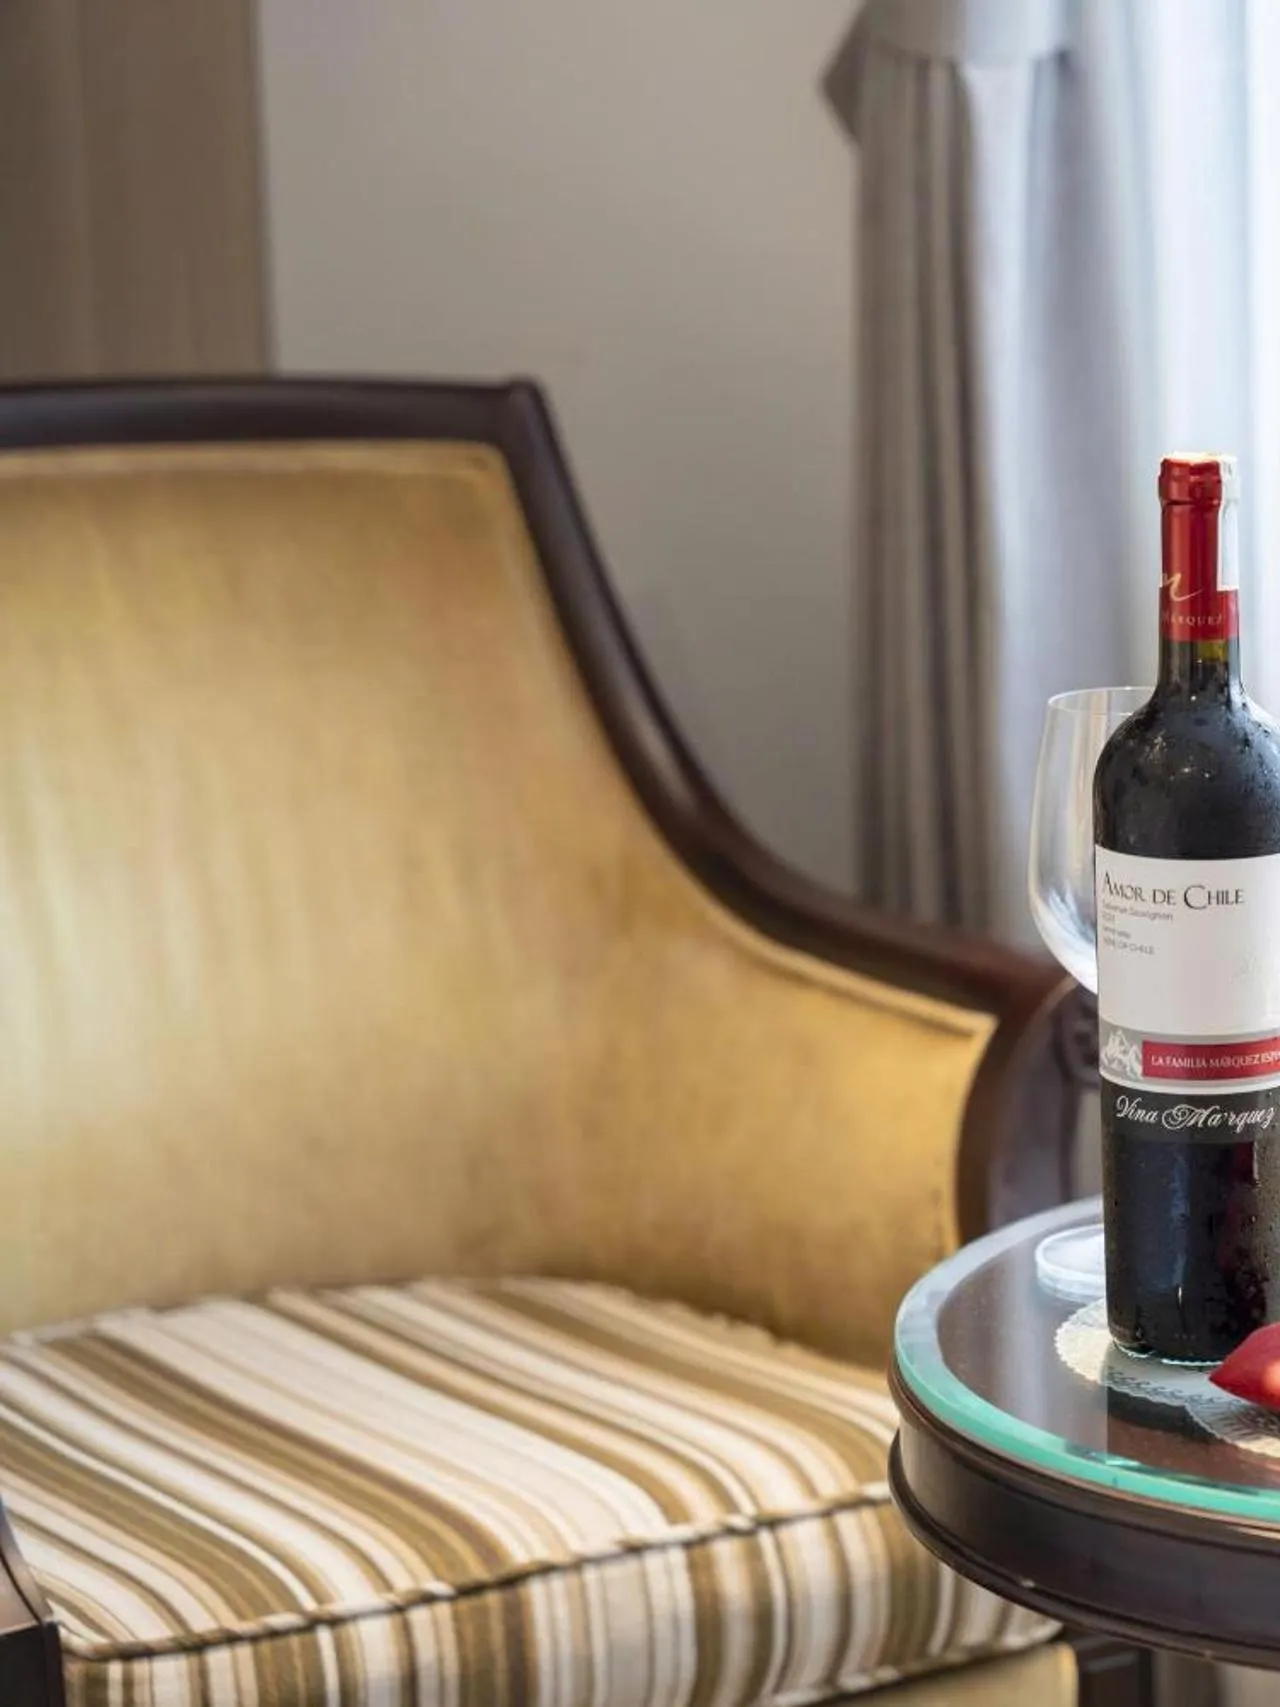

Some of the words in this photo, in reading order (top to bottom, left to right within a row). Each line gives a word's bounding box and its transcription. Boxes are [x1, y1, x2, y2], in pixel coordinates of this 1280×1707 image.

[1102, 870, 1146, 902] AMOR
[1152, 888, 1177, 906] DE
[1183, 884, 1245, 910] CHILE
[1151, 1055, 1164, 1067] LA
